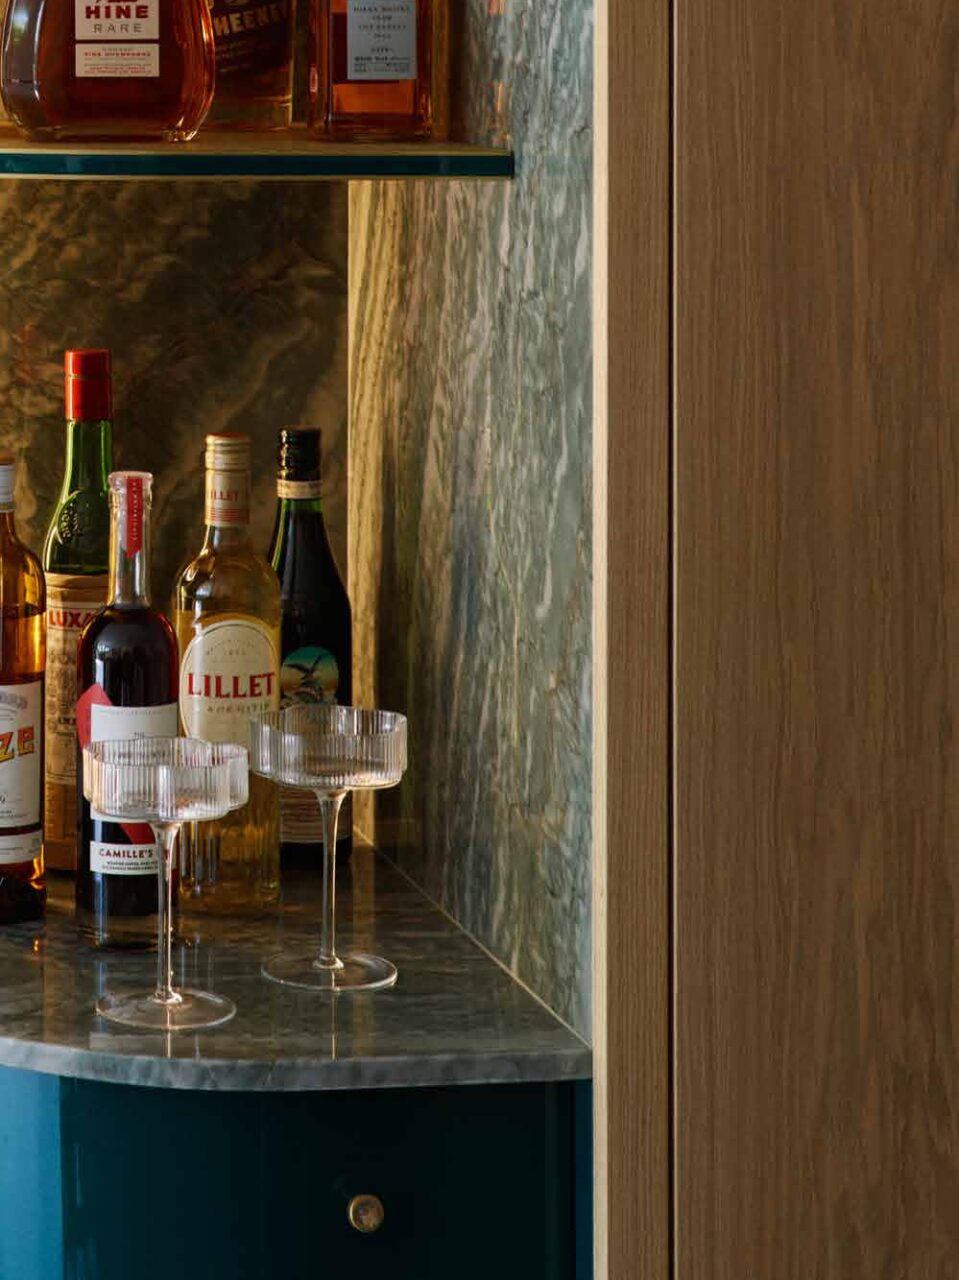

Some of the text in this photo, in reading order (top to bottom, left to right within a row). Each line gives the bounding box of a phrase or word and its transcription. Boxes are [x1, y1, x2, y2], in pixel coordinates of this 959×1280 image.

[85, 5, 149, 19] HINE
[94, 23, 142, 33] RARE
[187, 672, 275, 698] LILLET
[99, 847, 154, 860] CAMILLE'S
